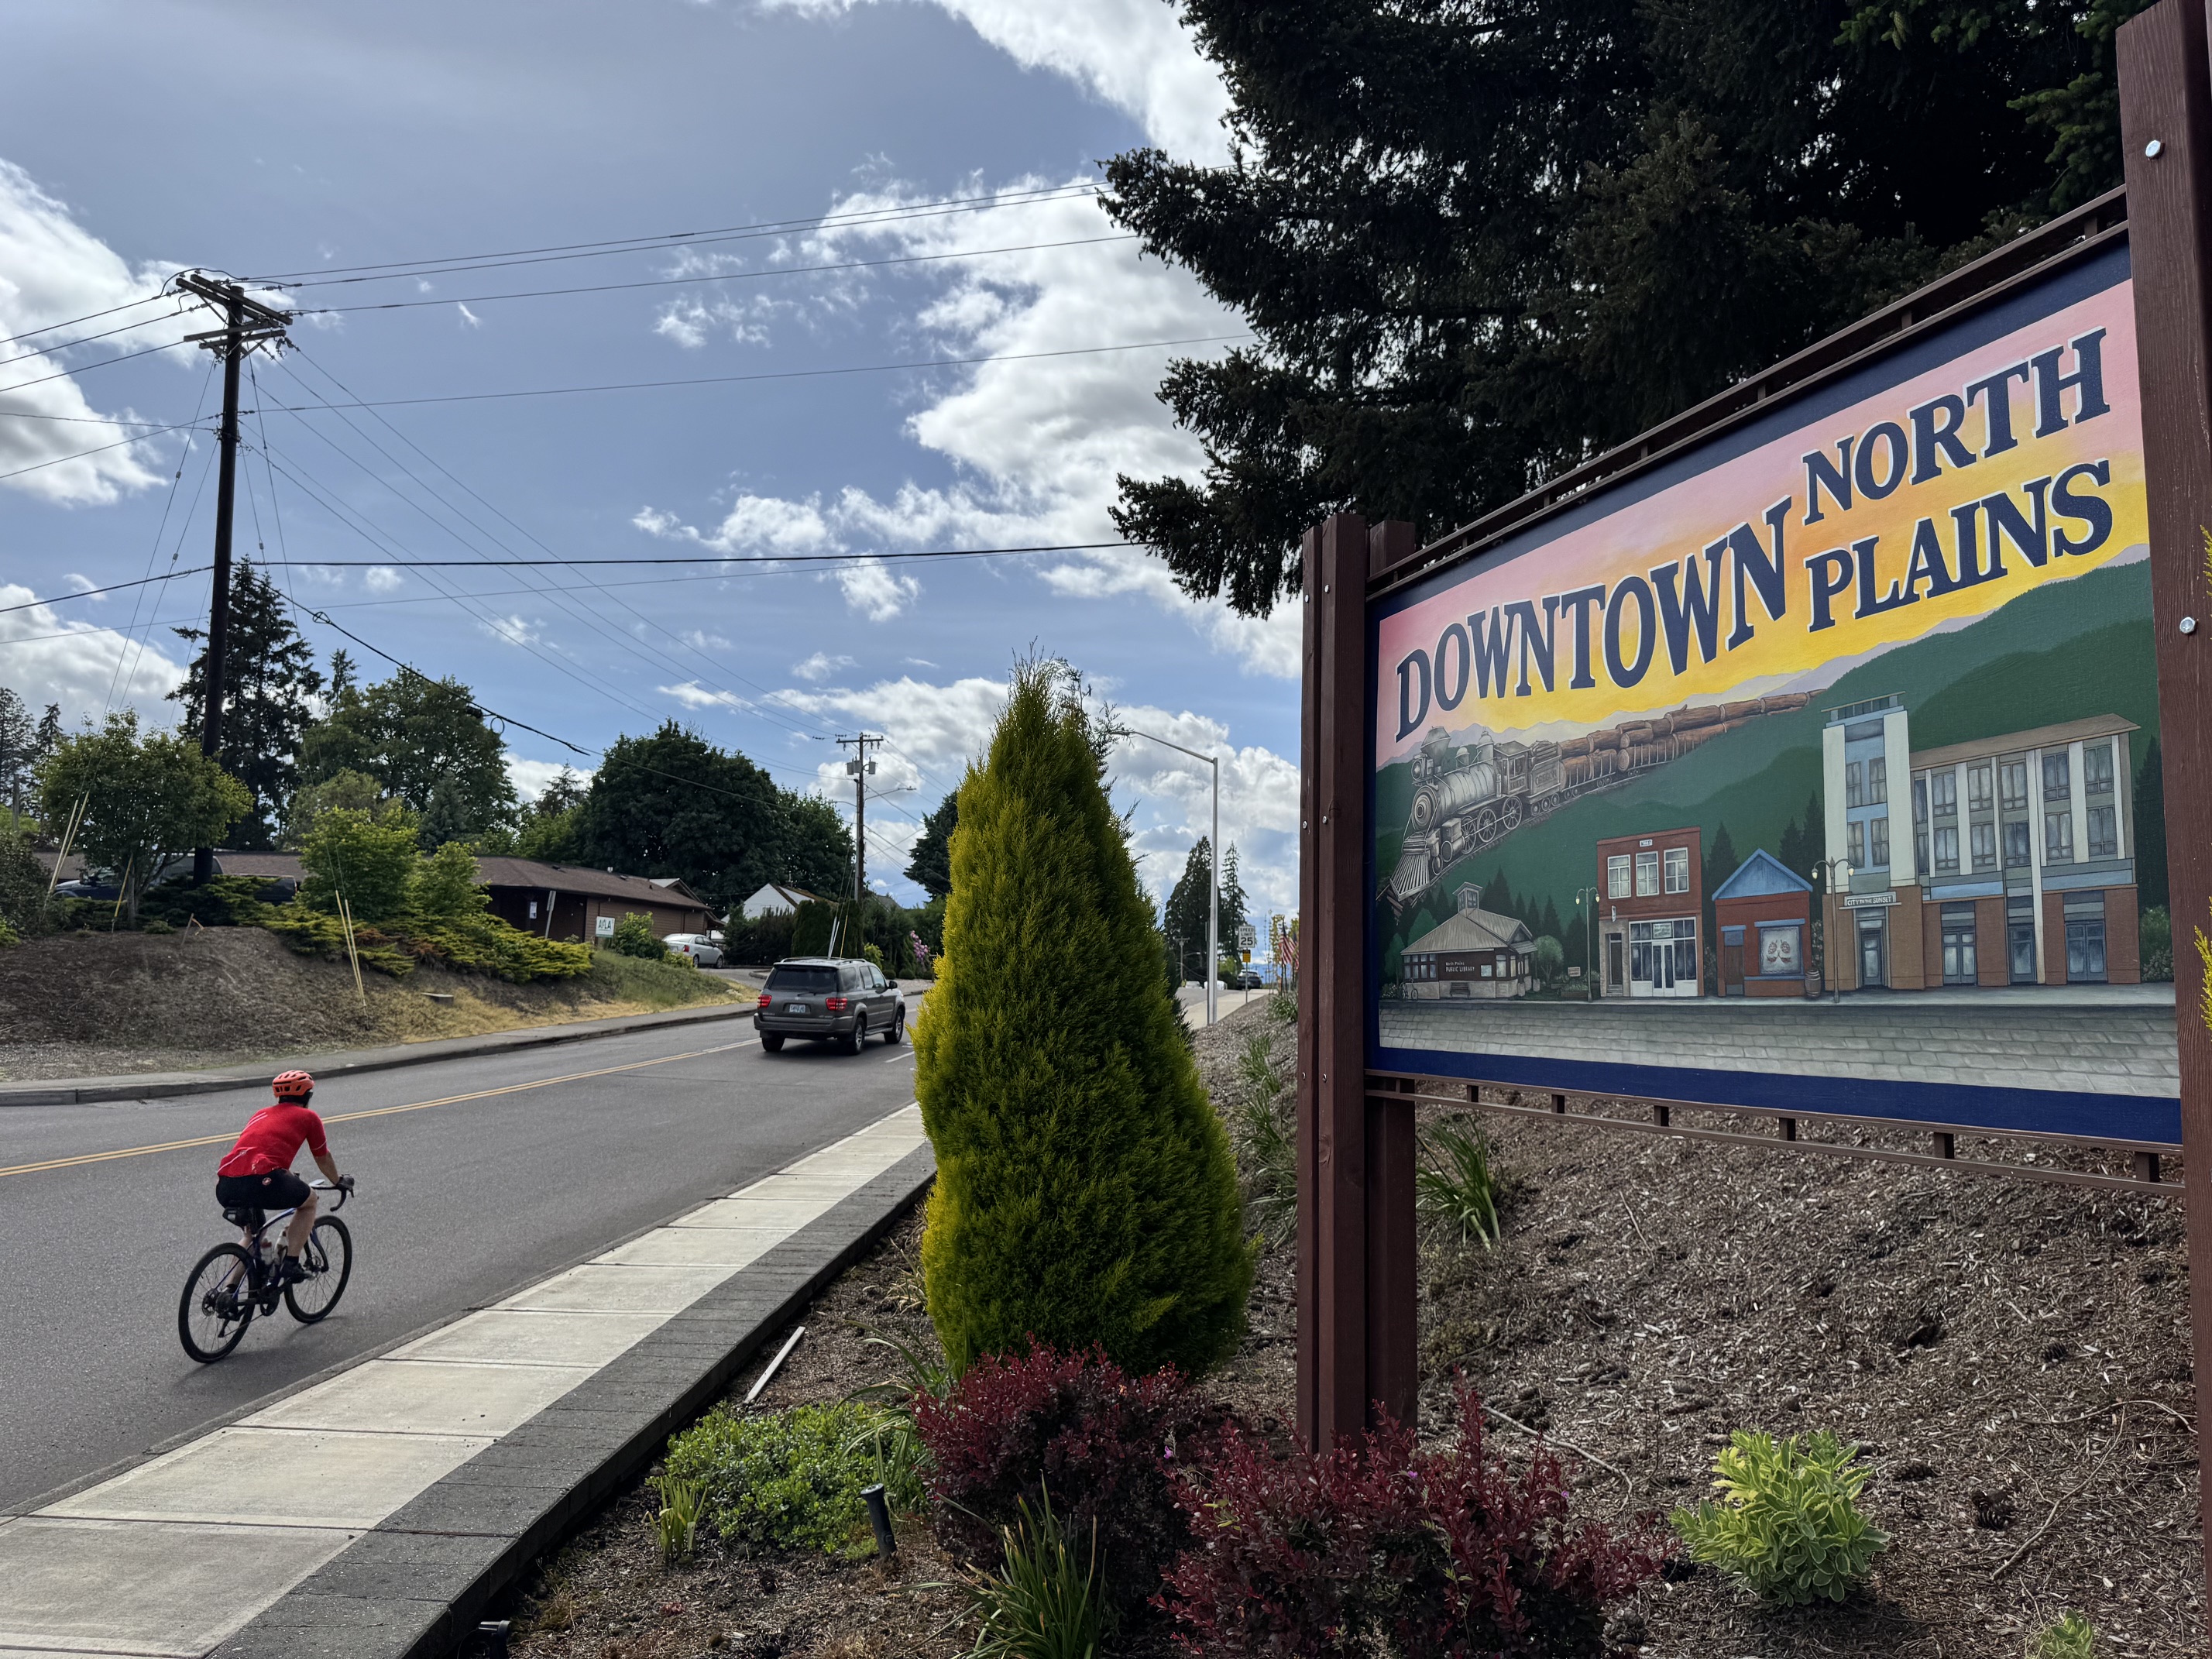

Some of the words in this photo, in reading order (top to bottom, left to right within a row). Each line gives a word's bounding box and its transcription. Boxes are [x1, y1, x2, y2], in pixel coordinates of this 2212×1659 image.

[1801, 326, 2111, 527] NORTH
[1395, 494, 1792, 744] DOWNTOWN
[1803, 458, 2113, 633] PLAINS
[1535, 770, 1557, 786] OREGON
[1240, 936, 1253, 946] 25
